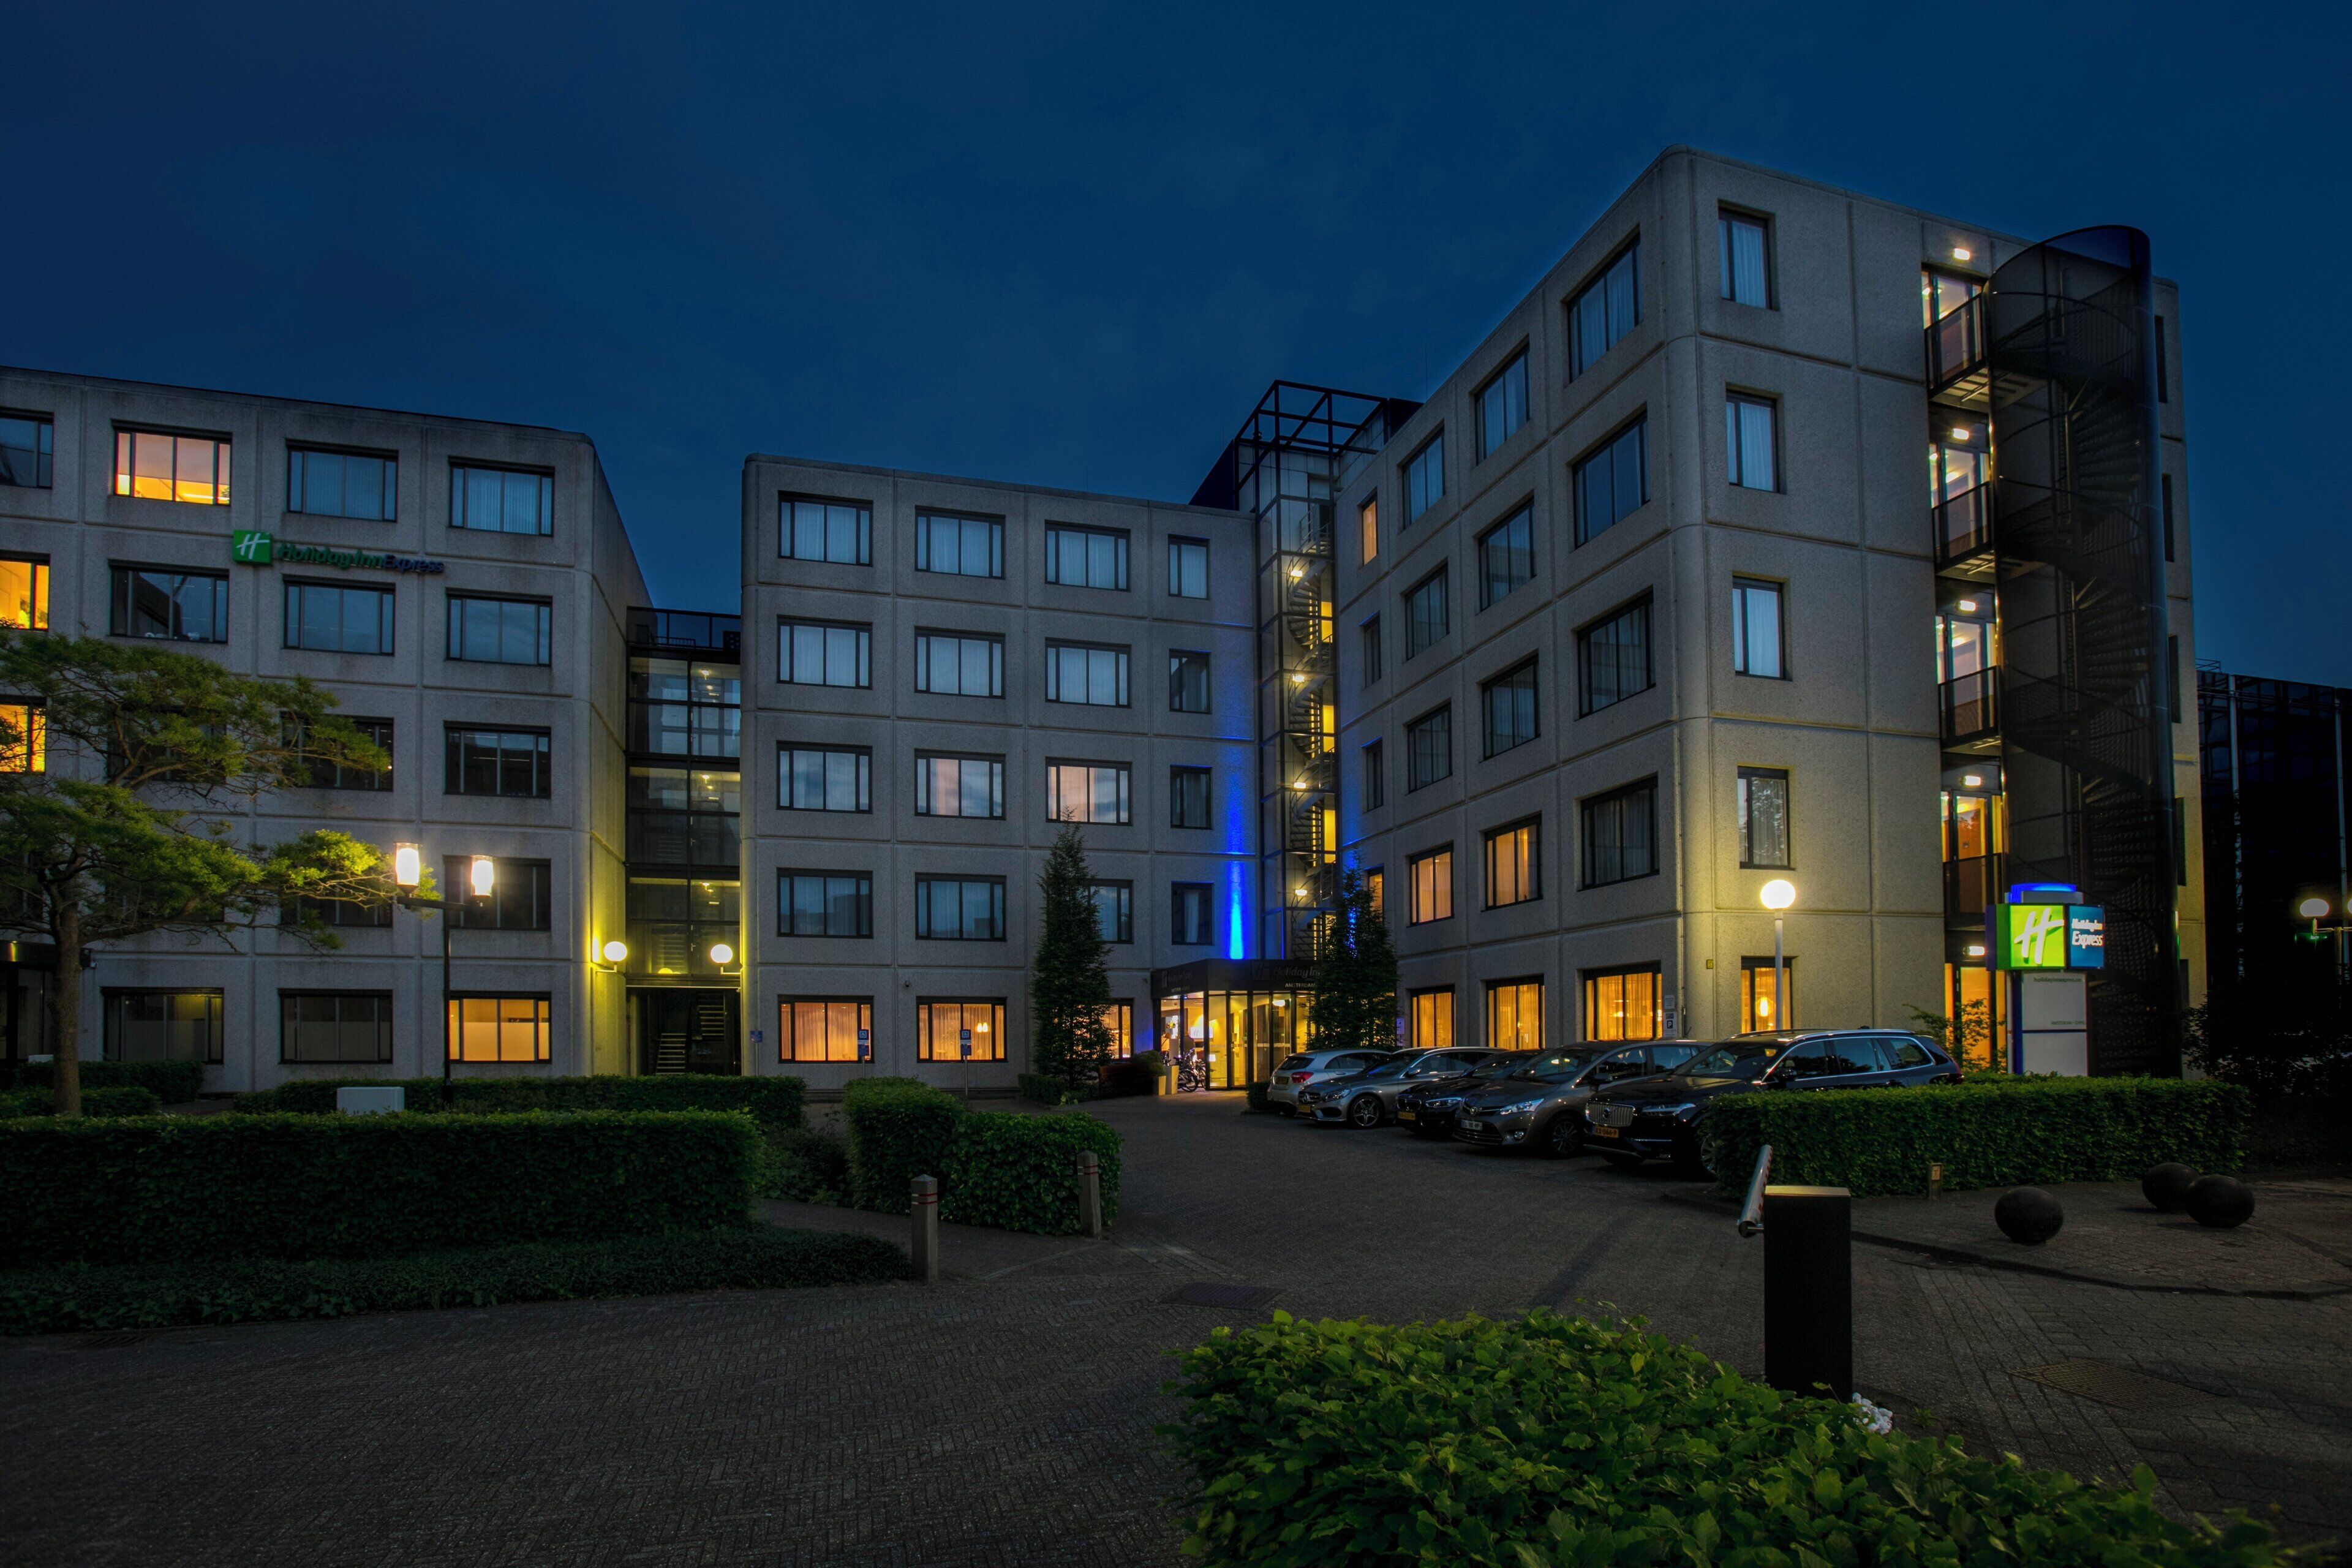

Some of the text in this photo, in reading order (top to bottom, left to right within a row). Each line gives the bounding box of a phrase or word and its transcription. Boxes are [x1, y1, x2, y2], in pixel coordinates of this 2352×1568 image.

[278, 543, 443, 574] Holiday Inn Express
[2072, 931, 2103, 949] Express
[1273, 966, 1308, 978] Holiday
